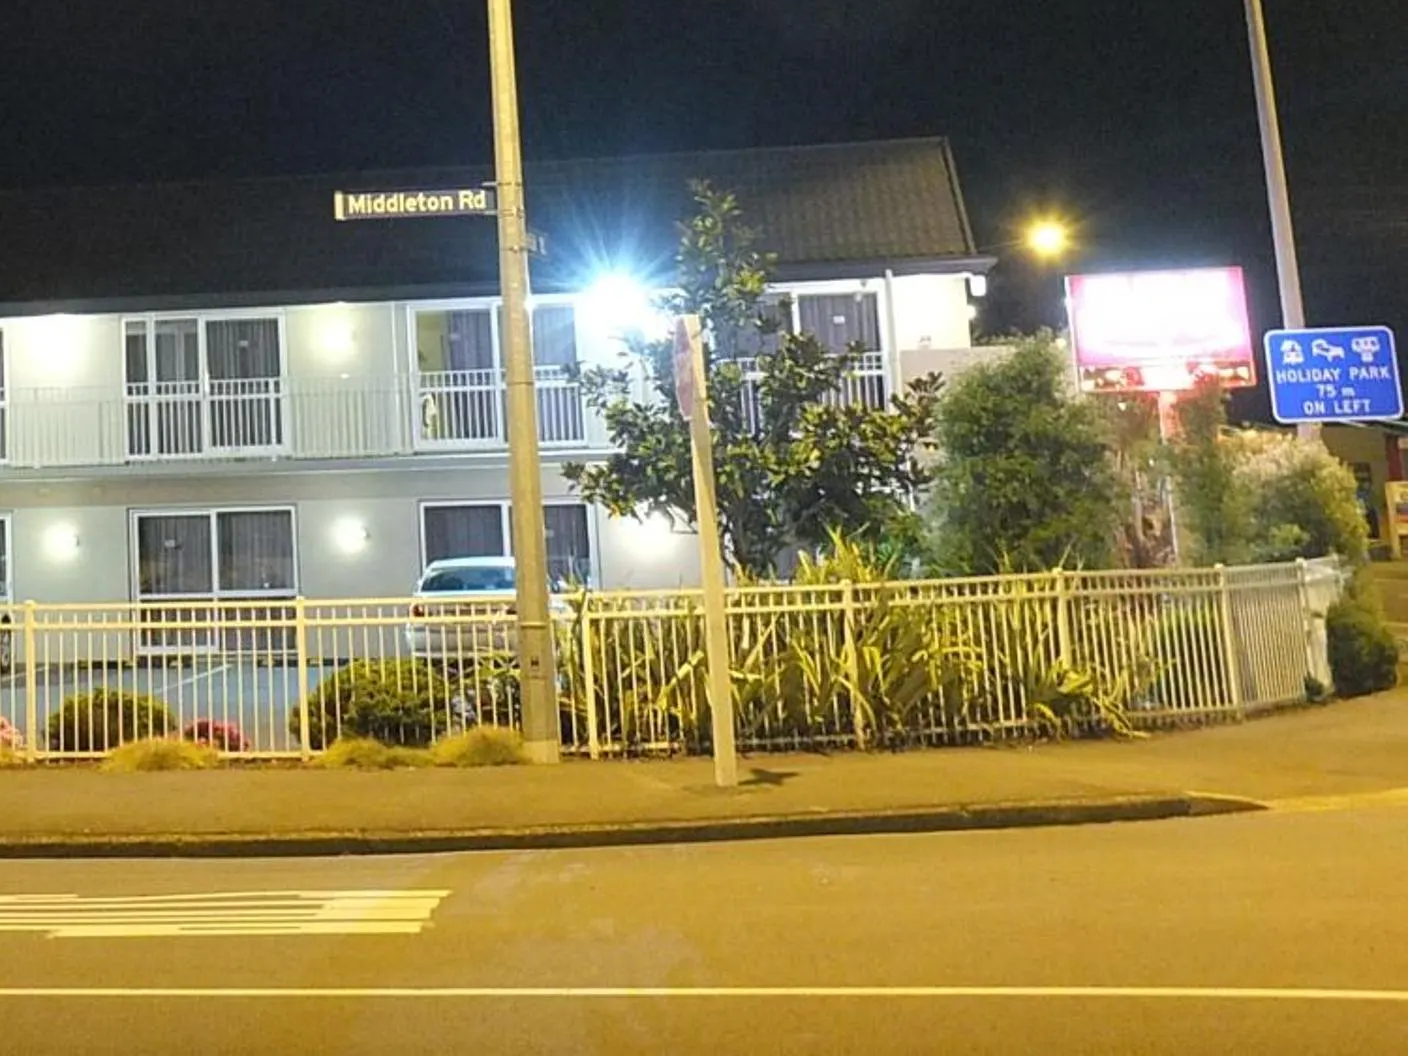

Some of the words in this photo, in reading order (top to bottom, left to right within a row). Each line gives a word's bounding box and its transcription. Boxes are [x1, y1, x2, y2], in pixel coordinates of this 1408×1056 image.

[348, 192, 453, 214] Middleton
[459, 190, 486, 209] Rd
[1276, 368, 1341, 384] HOLIDAY
[1349, 366, 1390, 379] PARK
[1316, 384, 1336, 398] 75
[1341, 387, 1355, 397] m
[1303, 401, 1325, 415] ON
[1334, 399, 1371, 413] LEFT
